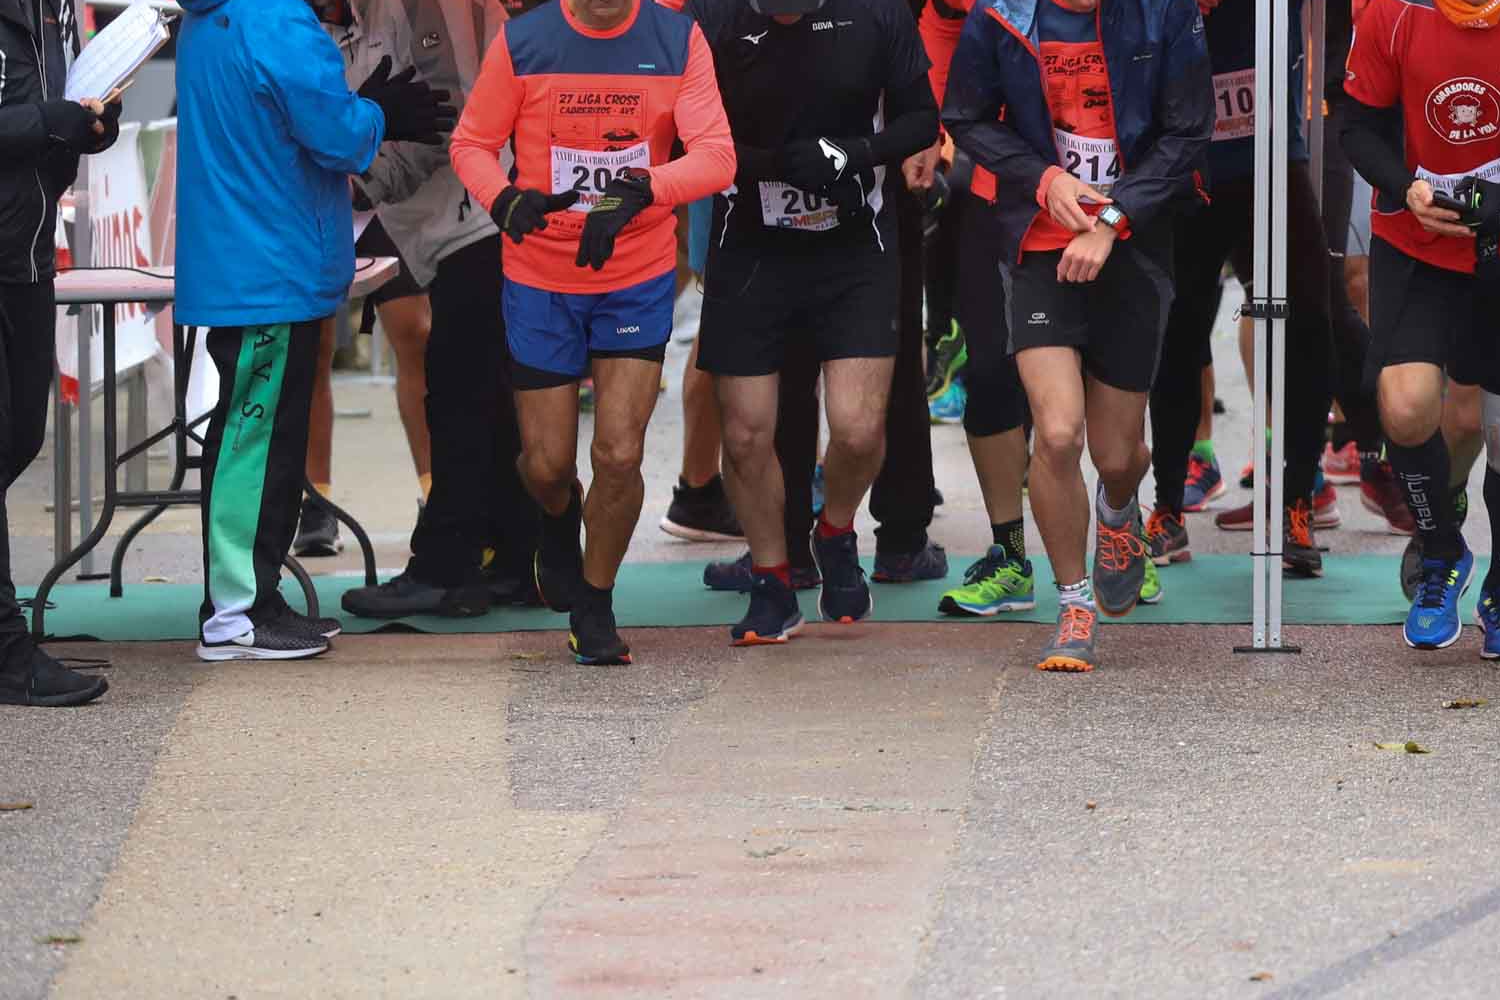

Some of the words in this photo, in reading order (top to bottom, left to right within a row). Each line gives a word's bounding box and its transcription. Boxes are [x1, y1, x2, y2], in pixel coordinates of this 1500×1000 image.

[1083, 54, 1104, 65] CRO
[559, 93, 574, 105] 27
[576, 93, 601, 105] LIGA
[604, 94, 641, 106] CROSS
[1217, 86, 1255, 117] 10
[1432, 82, 1487, 106] CORREDORES
[1448, 129, 1462, 140] DE
[1463, 127, 1478, 138] LA
[1065, 150, 1122, 183] 214
